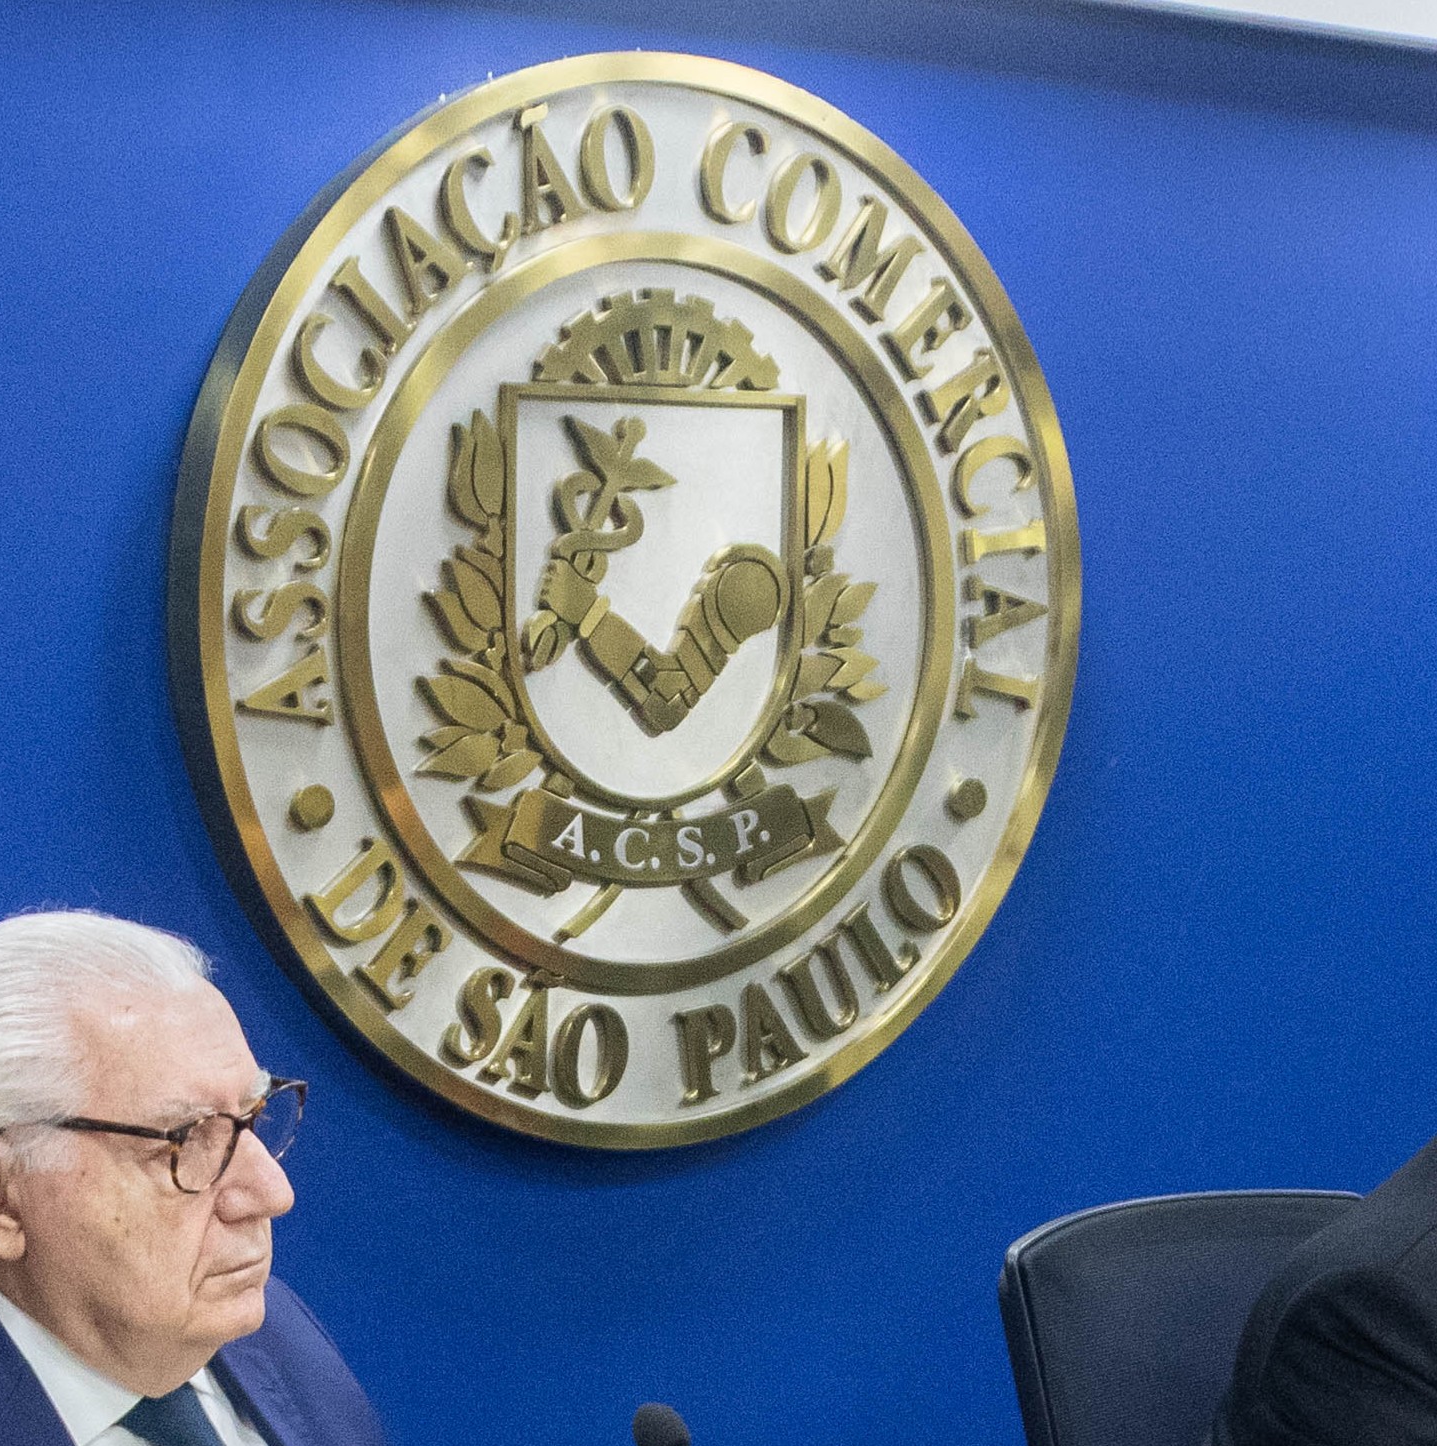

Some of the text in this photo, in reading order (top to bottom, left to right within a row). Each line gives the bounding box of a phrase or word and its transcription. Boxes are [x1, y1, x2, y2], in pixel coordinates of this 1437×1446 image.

[234, 103, 1050, 727] ASSOCIAÇÃO COMERCIAL
[303, 836, 962, 1109] DE SÃO PAULO
